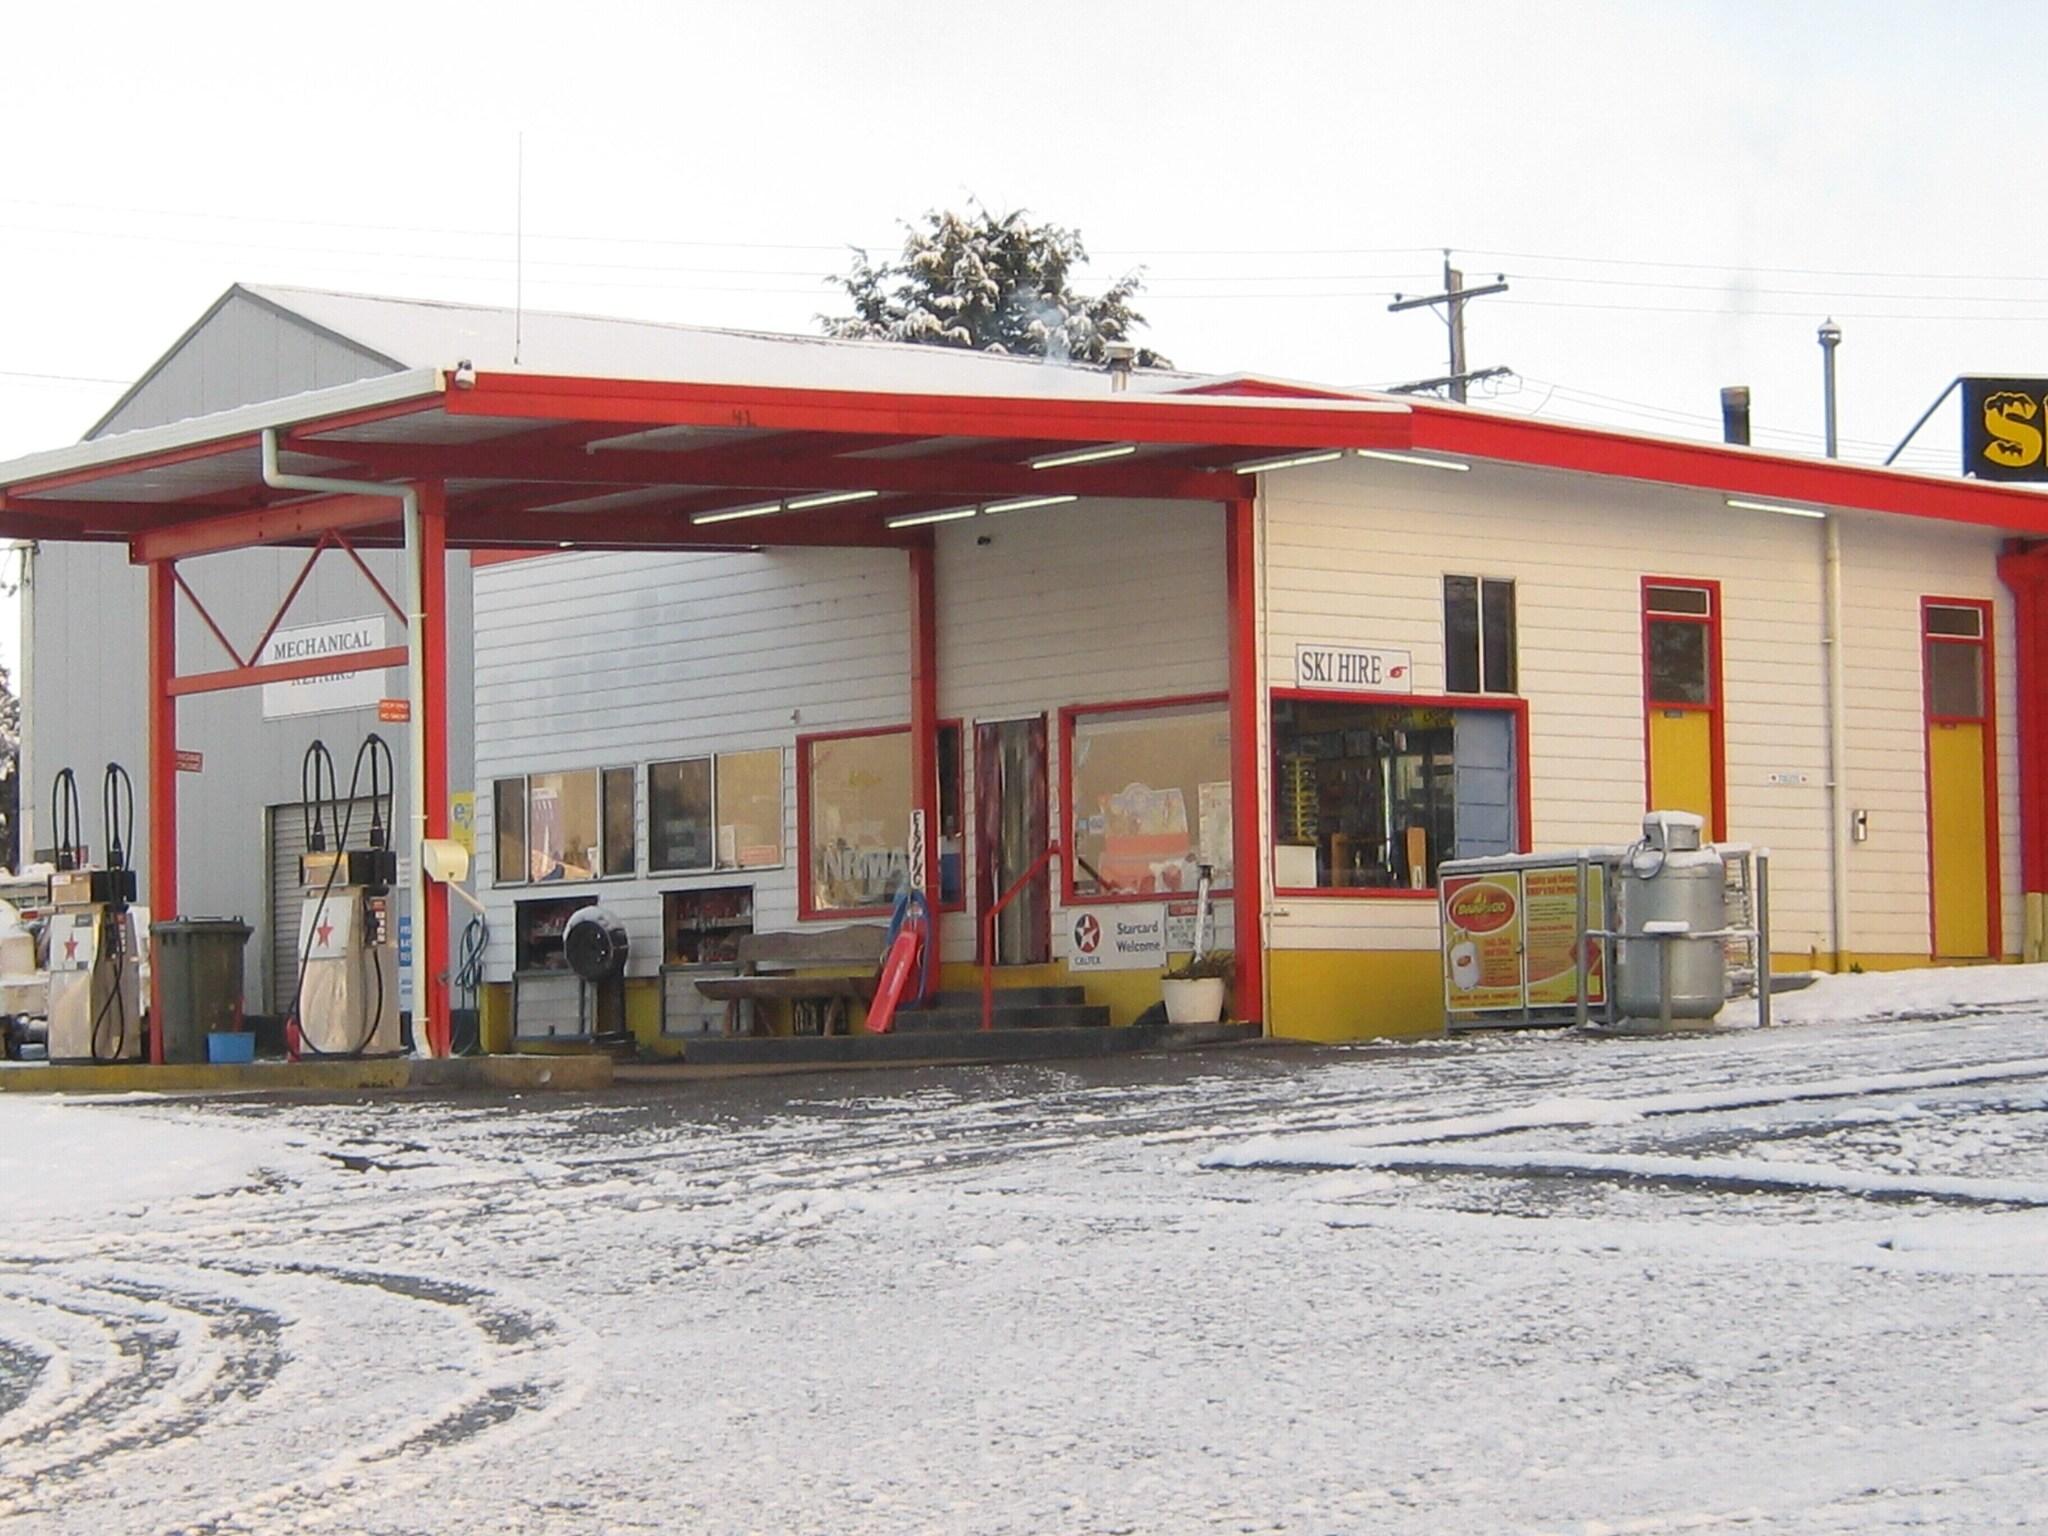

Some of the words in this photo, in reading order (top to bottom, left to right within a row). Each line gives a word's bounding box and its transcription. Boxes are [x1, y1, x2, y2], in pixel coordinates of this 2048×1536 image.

[1984, 391, 2048, 468] S
[274, 630, 372, 660] MECHANICAL
[1302, 651, 1333, 682] SKI
[1337, 653, 1382, 685] HIRE
[1116, 940, 1160, 952] Welcome
